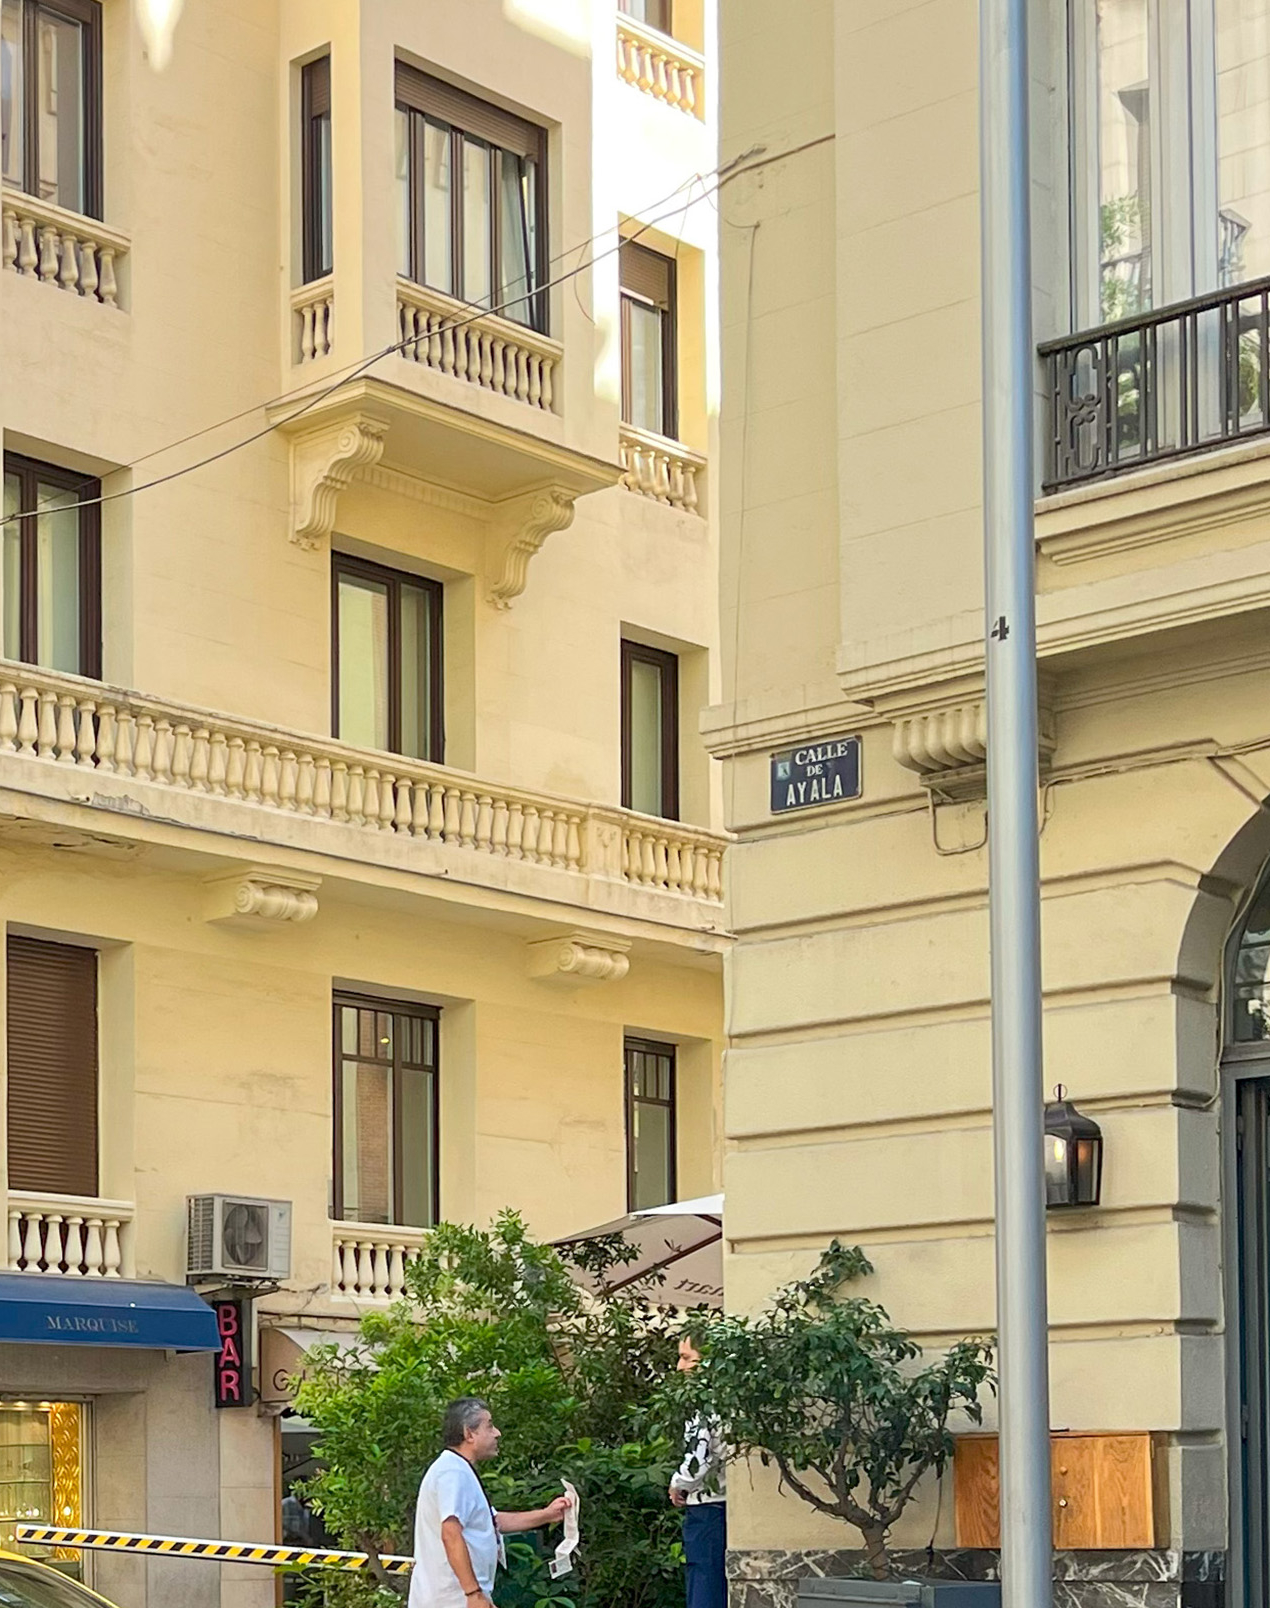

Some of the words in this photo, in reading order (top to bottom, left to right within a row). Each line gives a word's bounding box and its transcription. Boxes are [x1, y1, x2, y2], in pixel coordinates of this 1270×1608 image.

[795, 742, 848, 765] CALLE
[806, 764, 824, 777] DE
[786, 774, 843, 806] AYALA
[46, 1315, 140, 1333] MARQUISE
[218, 1304, 241, 1402] BAR
